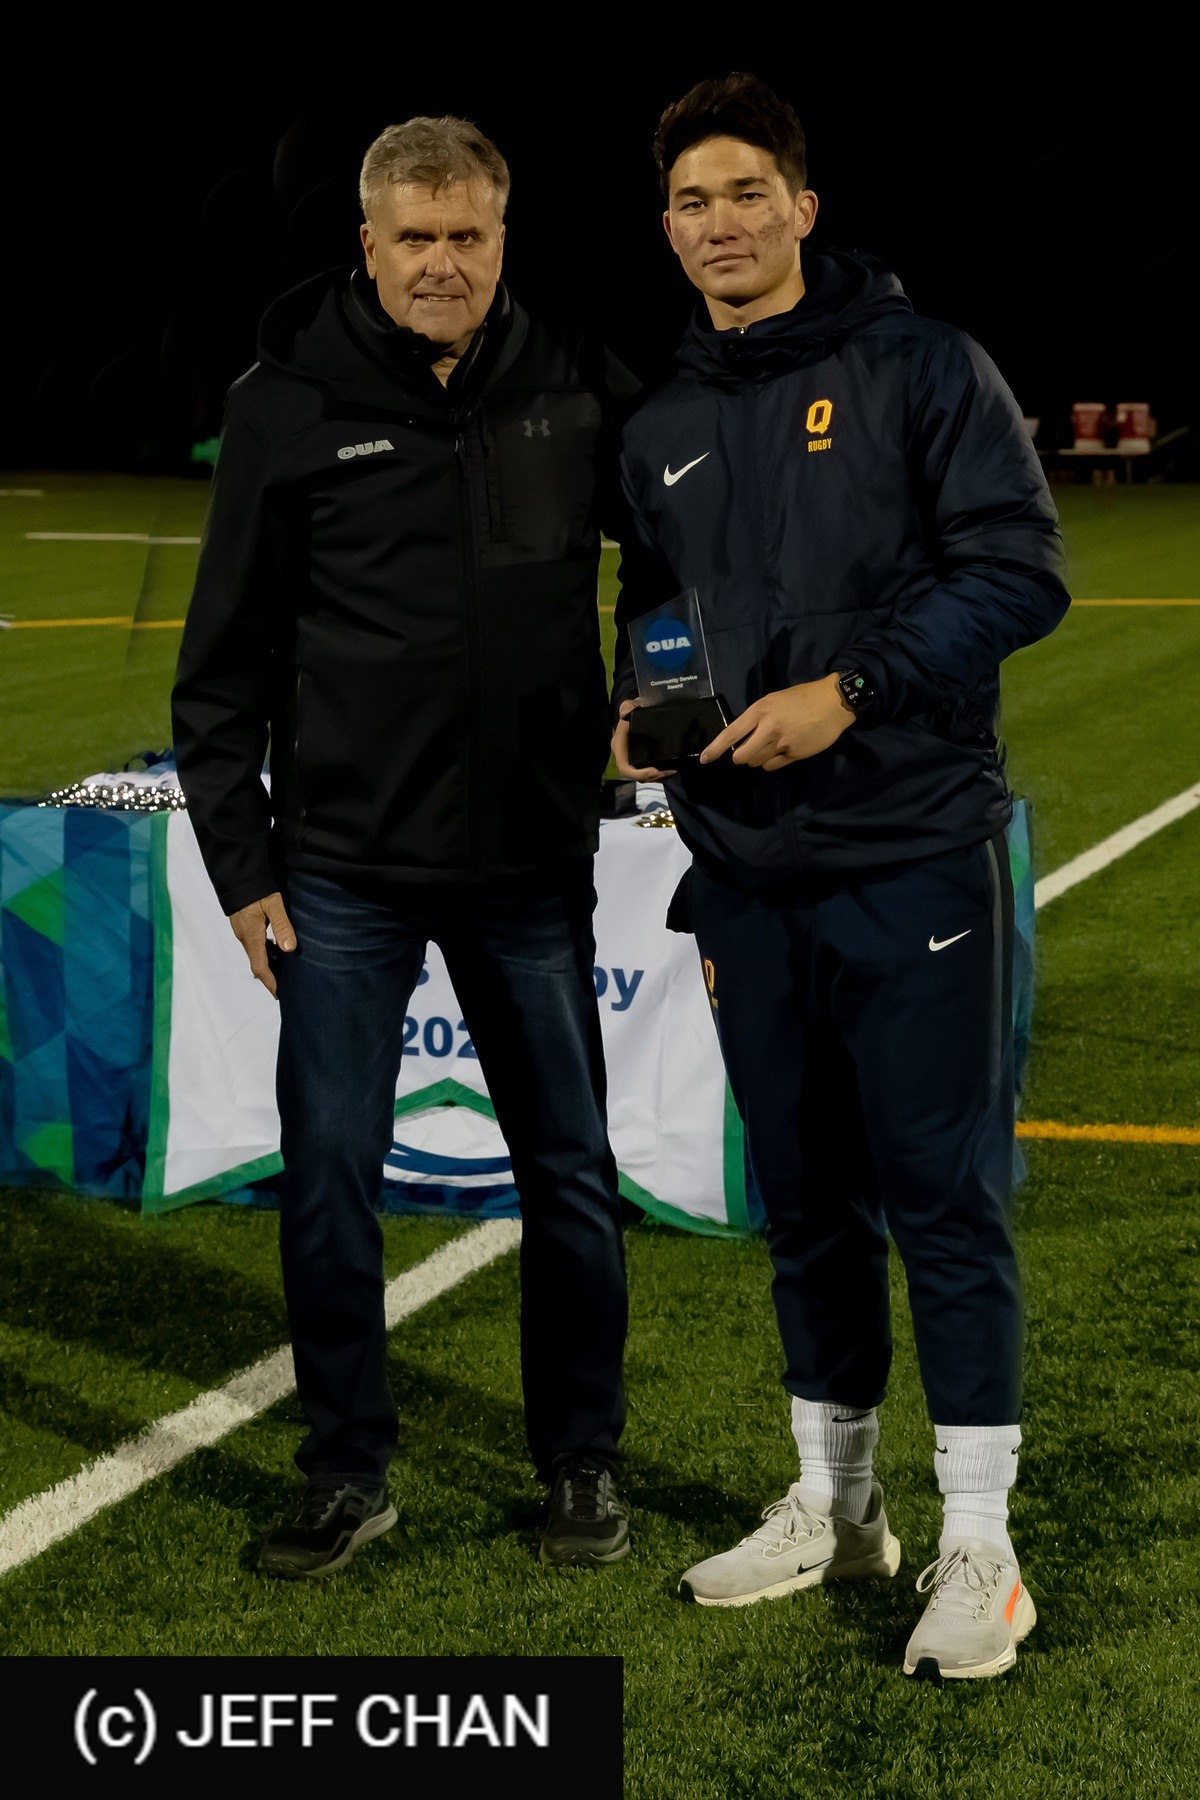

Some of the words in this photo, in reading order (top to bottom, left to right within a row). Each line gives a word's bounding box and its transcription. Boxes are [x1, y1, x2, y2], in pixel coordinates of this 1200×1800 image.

[806, 399, 833, 434] Q
[337, 439, 394, 460] OUA
[808, 438, 832, 452] RUGBY
[646, 636, 691, 653] OUA
